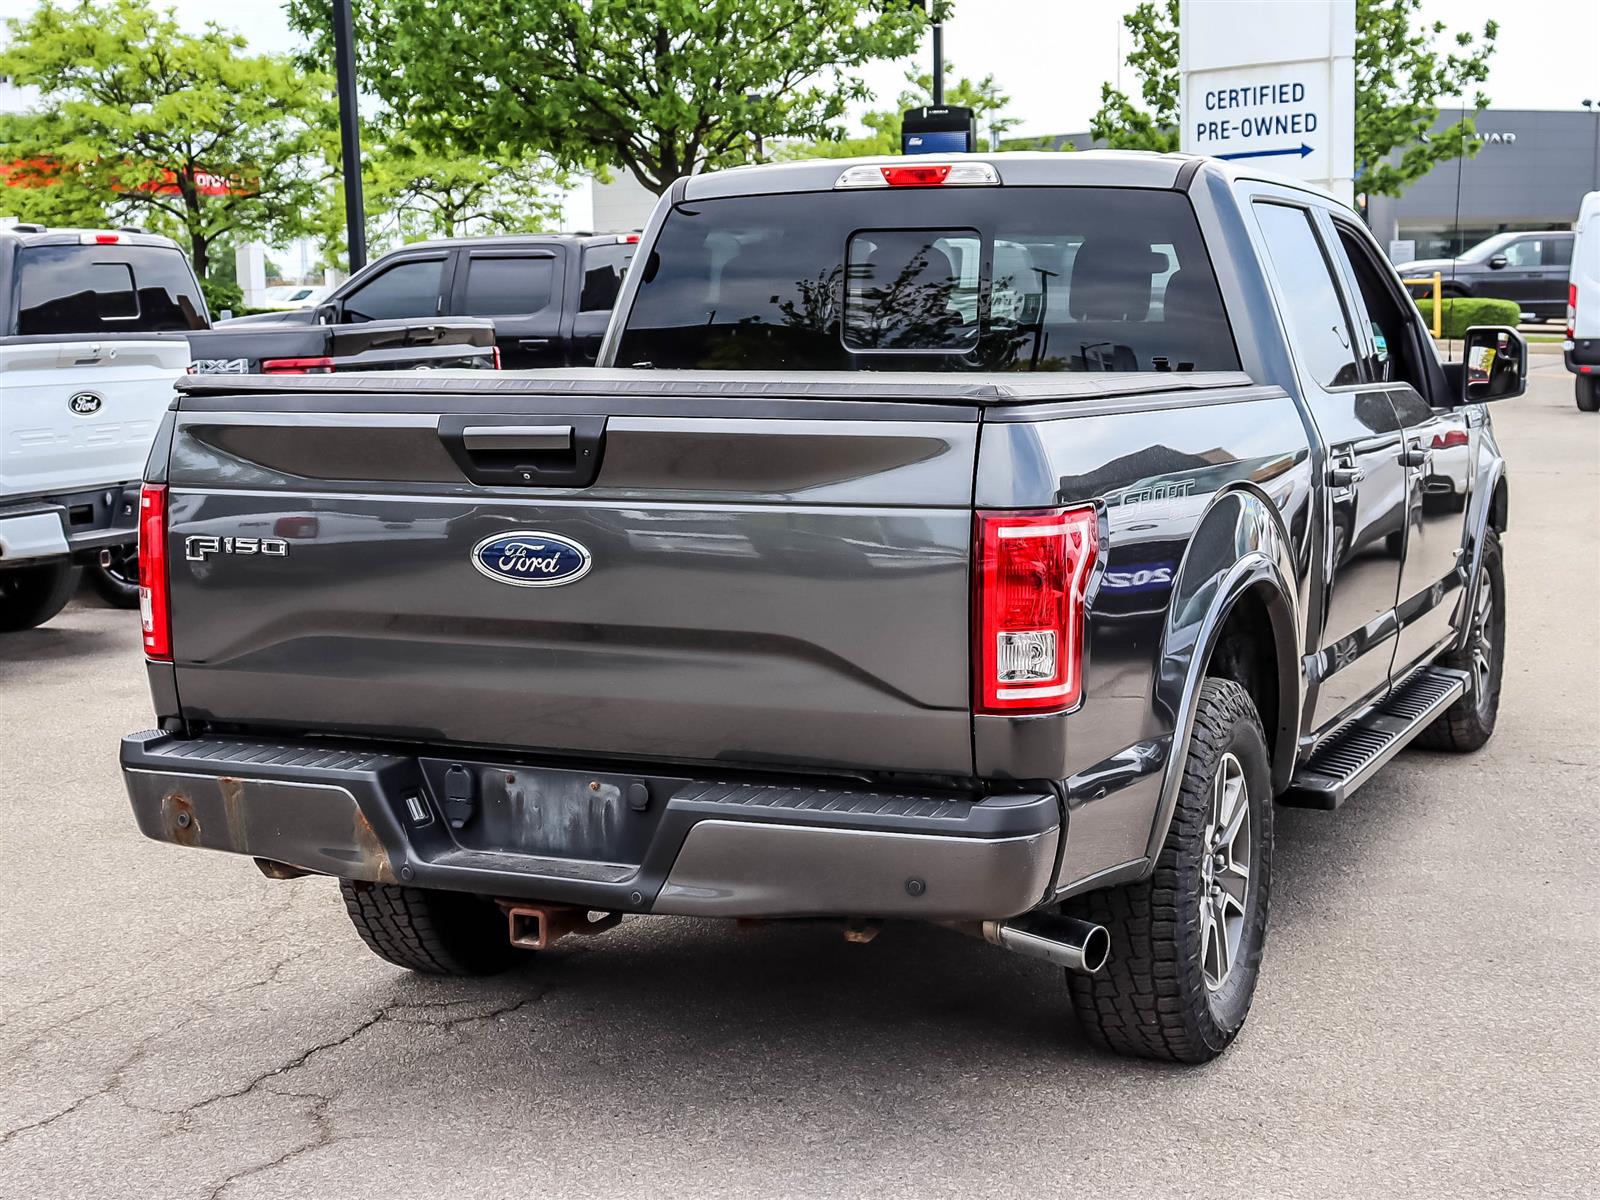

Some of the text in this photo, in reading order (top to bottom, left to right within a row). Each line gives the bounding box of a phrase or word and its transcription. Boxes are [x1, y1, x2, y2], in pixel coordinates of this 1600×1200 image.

[1205, 82, 1305, 111] CERTIFIED
[1196, 112, 1318, 142] PRE-OWNED
[73, 395, 99, 412] Ford
[498, 541, 562, 574] Ford
